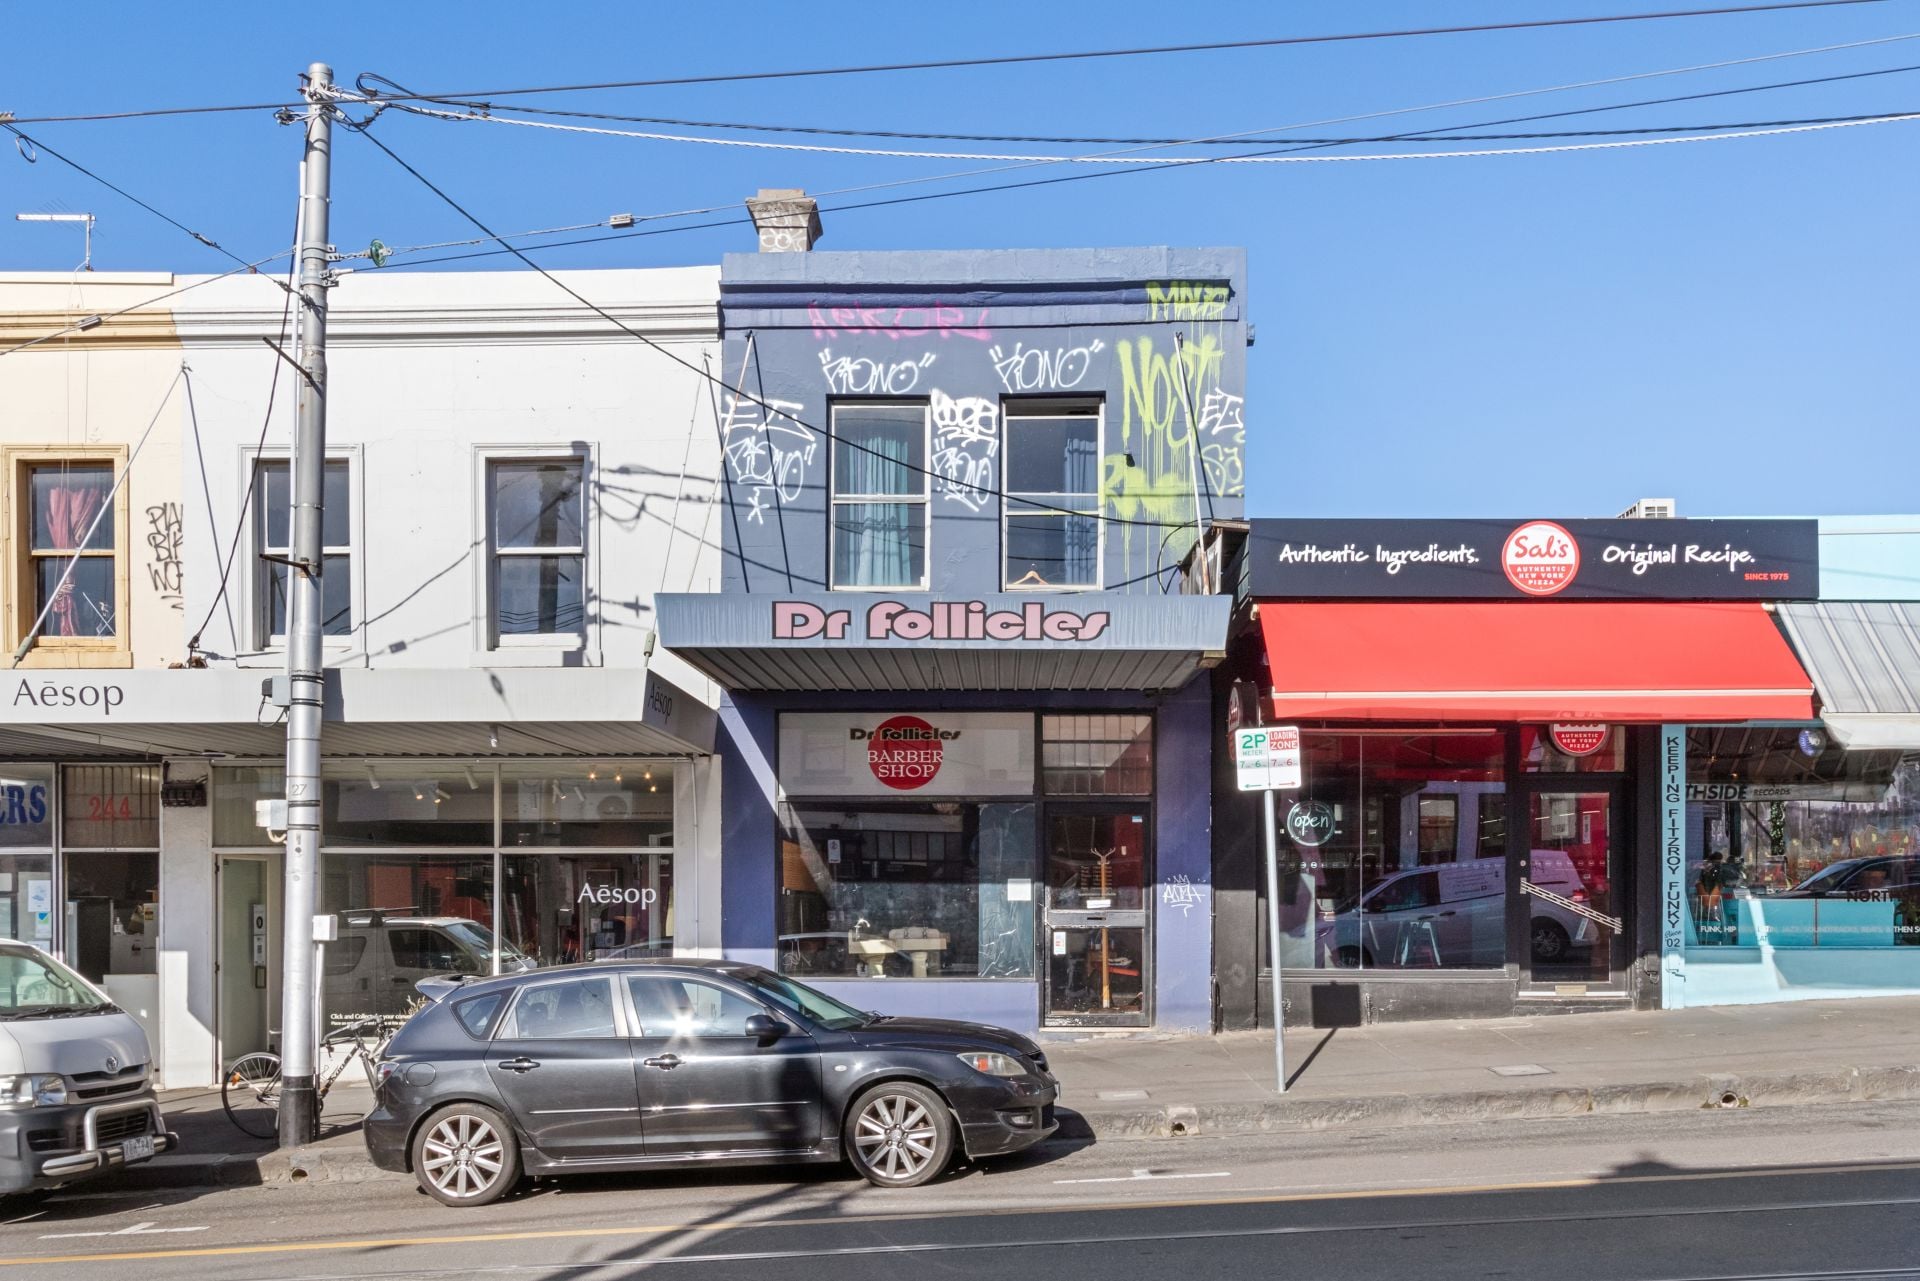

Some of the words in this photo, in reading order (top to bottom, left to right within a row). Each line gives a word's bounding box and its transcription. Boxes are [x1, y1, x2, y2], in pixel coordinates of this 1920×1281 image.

[1514, 535, 1569, 558] Sal's
[1279, 543, 1369, 563] Authentic
[1376, 543, 1480, 575] Ingredients.
[1602, 543, 1677, 576] Original
[1684, 543, 1756, 573] Recipe.
[1744, 572, 1769, 581] SINCE
[1770, 572, 1790, 581] 1975
[772, 600, 851, 640] Dr
[849, 728, 875, 740] Dr
[1241, 734, 1267, 749] 2P
[1270, 731, 1298, 740] LOADING
[1270, 740, 1299, 749] ZONE
[867, 750, 944, 763] BARBER
[878, 764, 935, 778] SHOP
[1665, 736, 1680, 803] KEEPING
[291, 783, 308, 797] 27
[1753, 787, 1792, 797] RECORDS
[88, 795, 132, 823] 244
[1294, 811, 1329, 837] open
[1666, 808, 1681, 876] FITZROY
[1667, 881, 1681, 929] FUNKY
[1700, 926, 1722, 934] FUNK,
